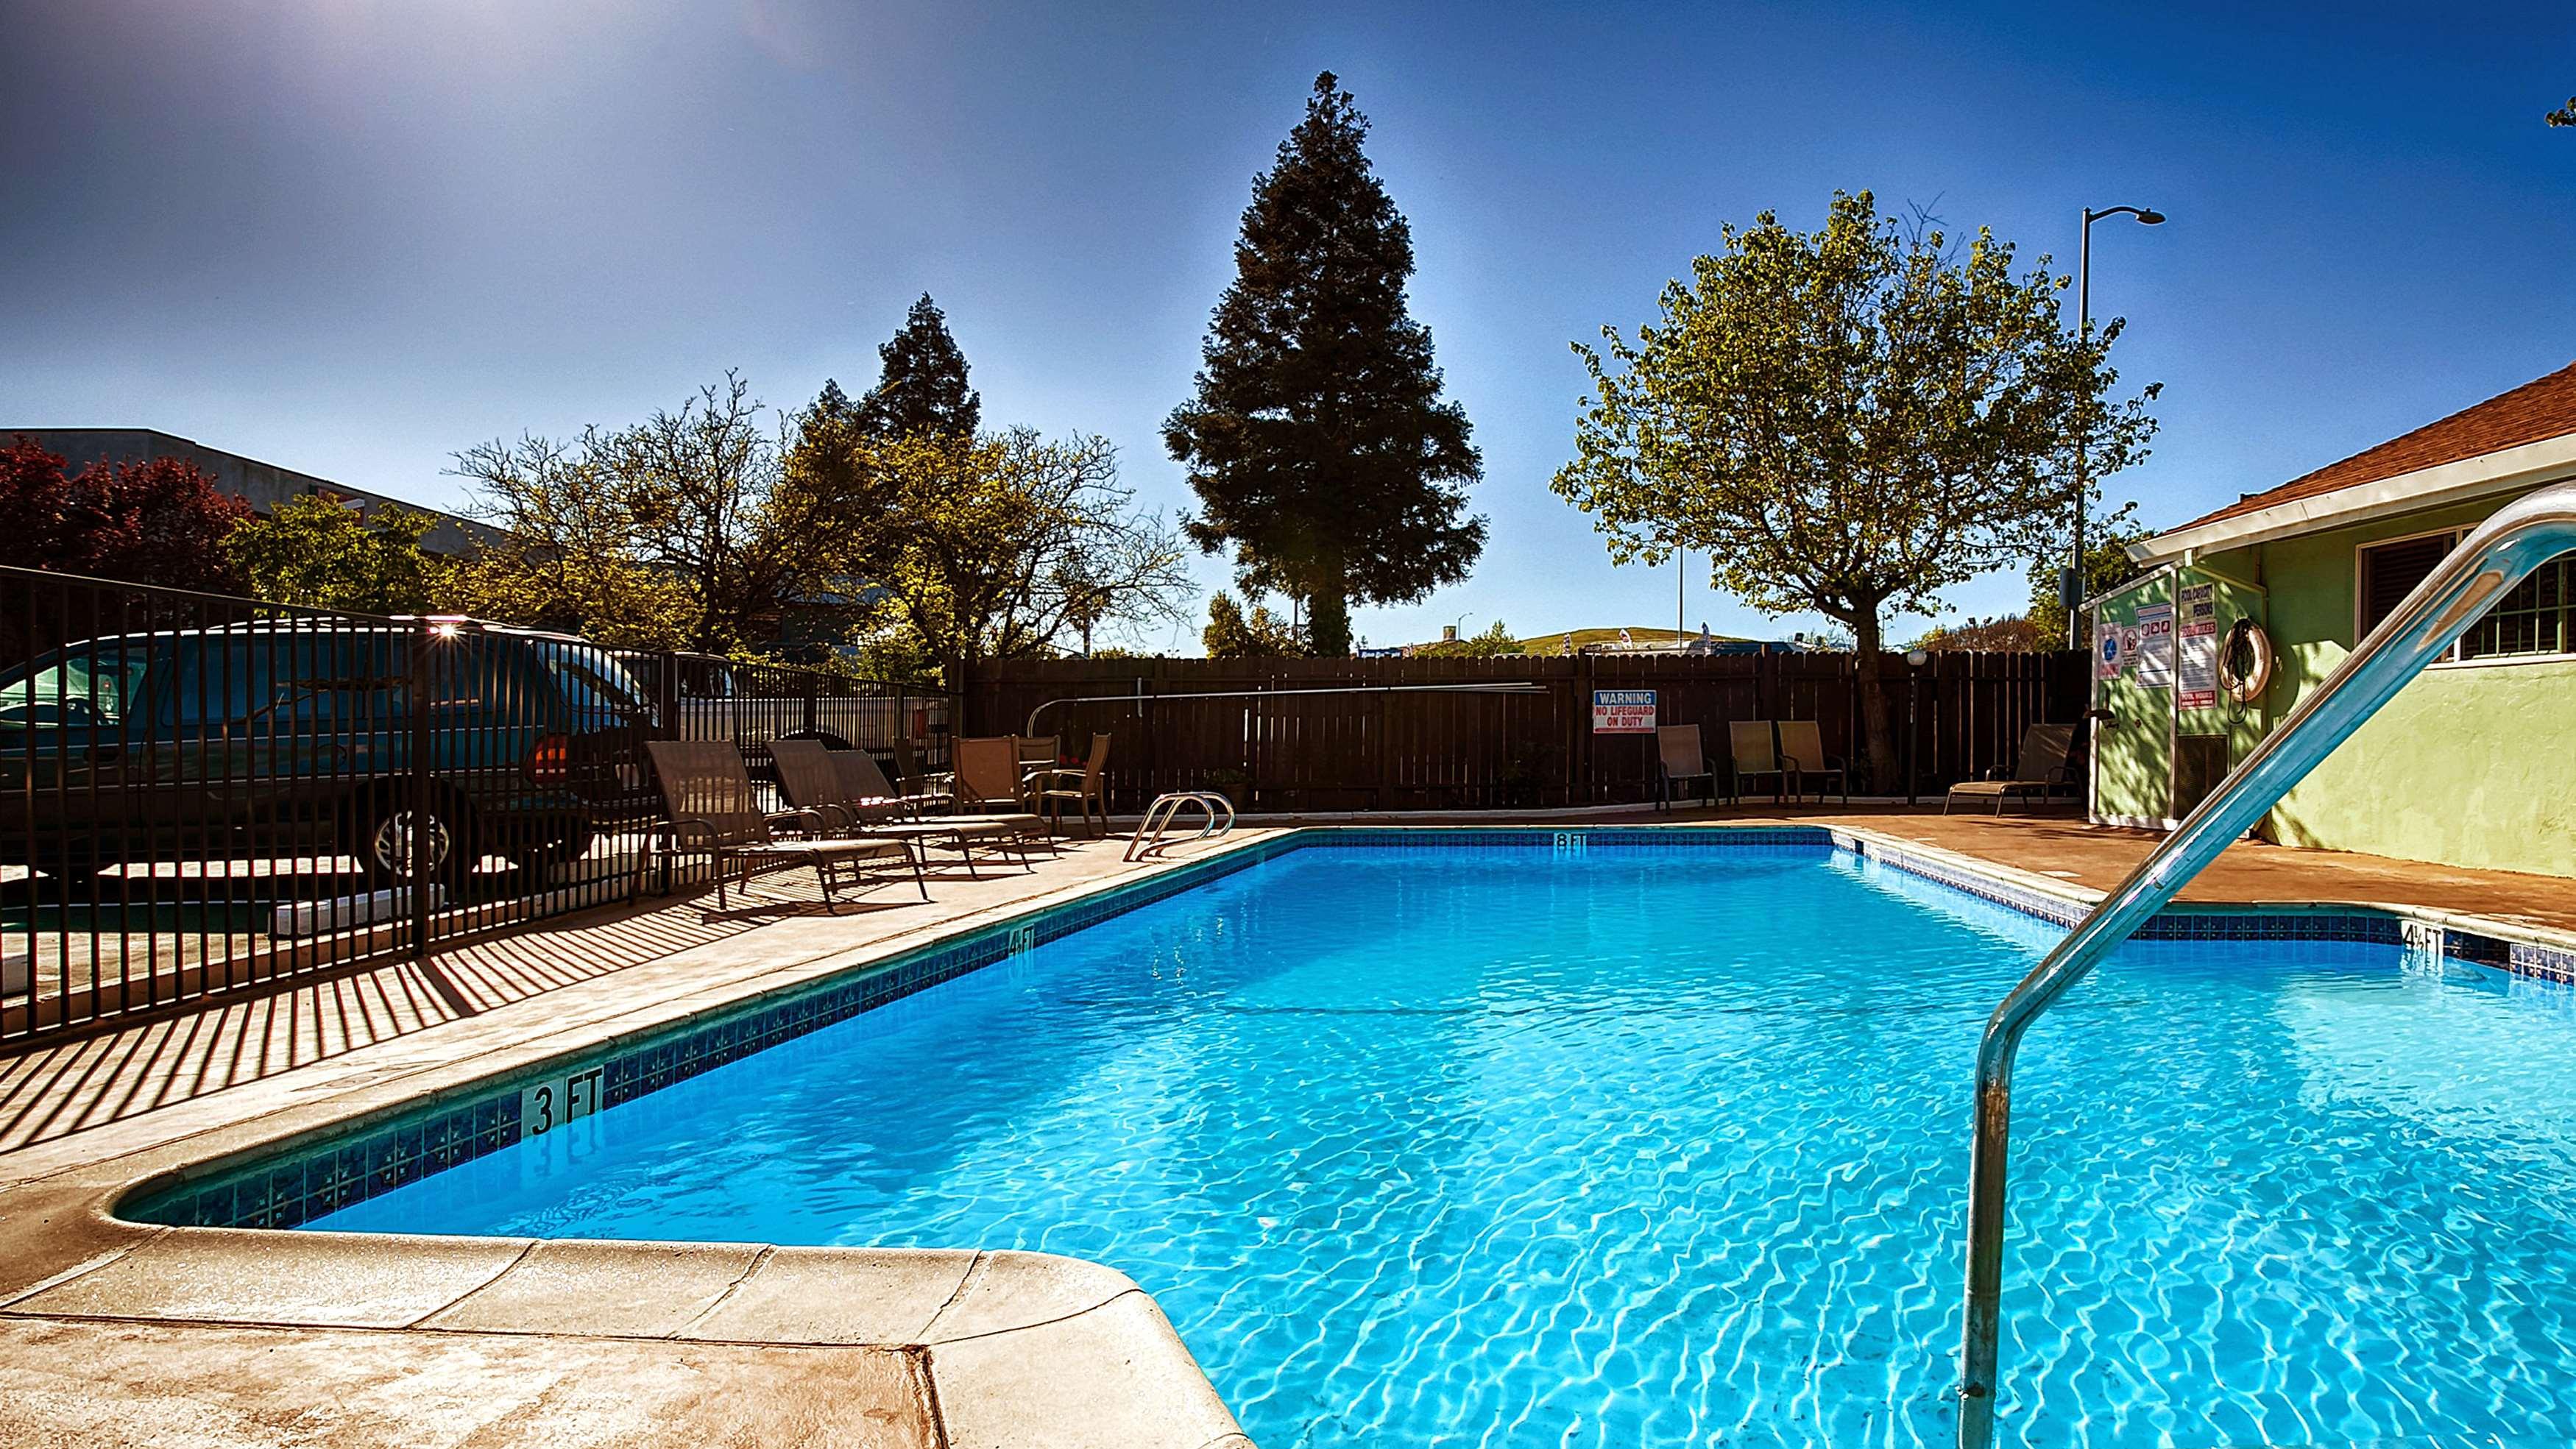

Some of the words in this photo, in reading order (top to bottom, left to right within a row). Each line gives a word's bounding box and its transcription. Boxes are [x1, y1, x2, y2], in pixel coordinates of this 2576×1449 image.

[1599, 692, 1652, 704] WARNING
[1596, 706, 1607, 716] NO
[1610, 706, 1655, 716] LIFEGUARD
[1607, 717, 1618, 726] ON
[1621, 717, 1643, 726] DUTY
[1557, 833, 1567, 846] 8
[1570, 833, 1586, 846] FT
[1022, 926, 1034, 953] FT
[2424, 927, 2441, 955] FT
[531, 1085, 553, 1136] 3
[566, 1068, 604, 1124] FT
